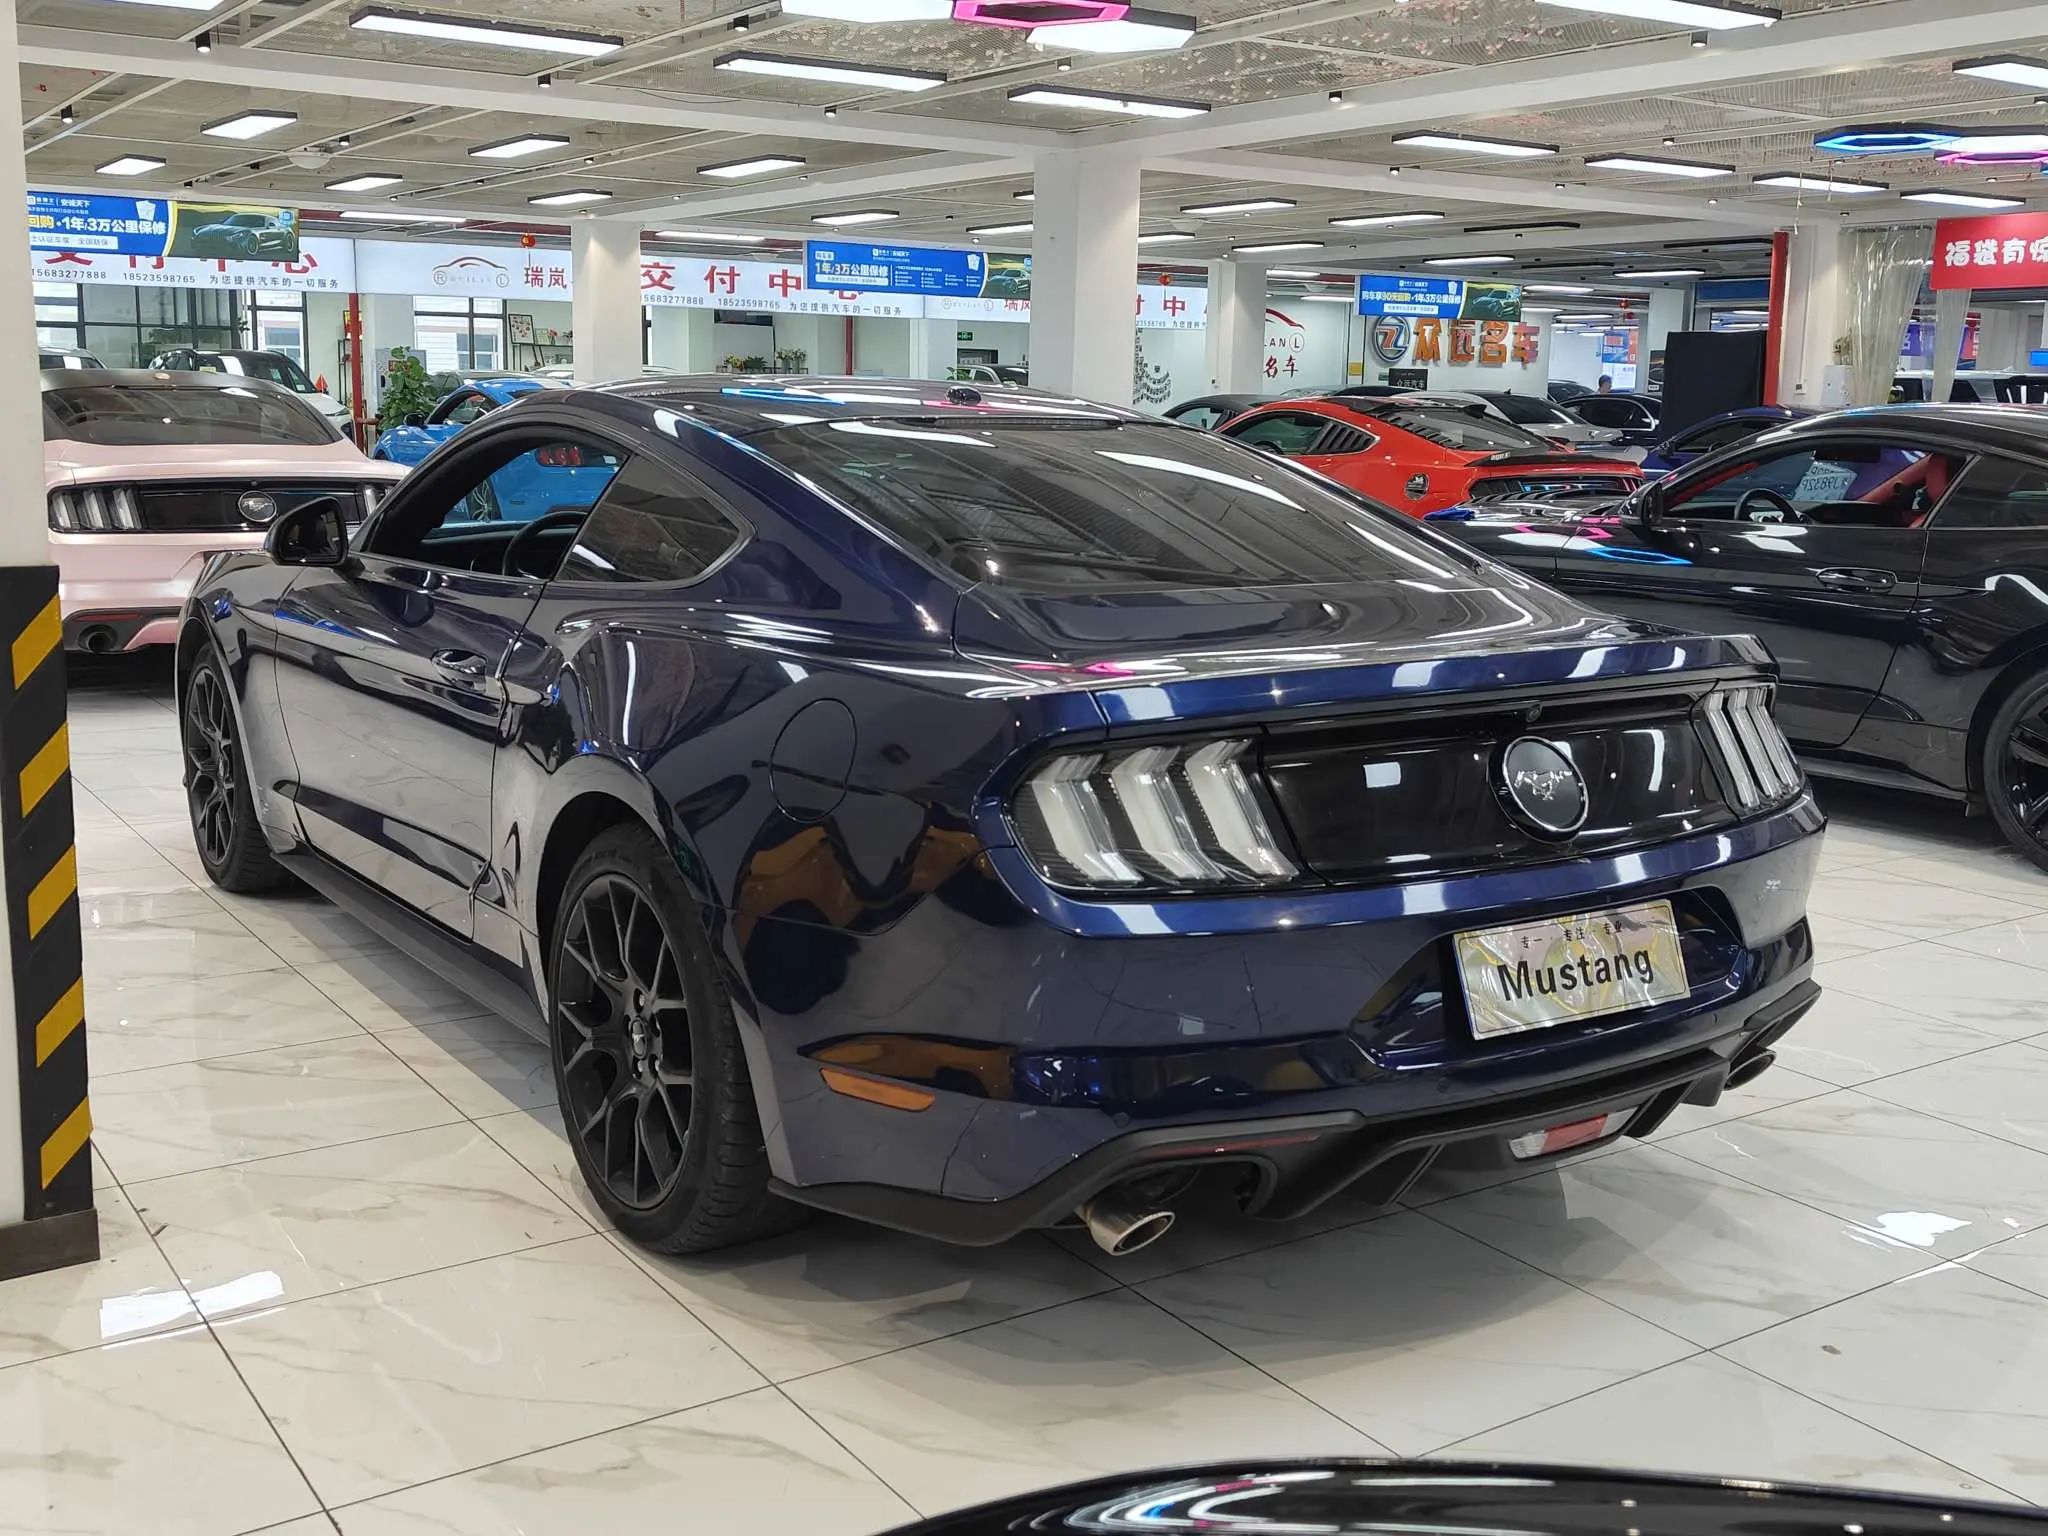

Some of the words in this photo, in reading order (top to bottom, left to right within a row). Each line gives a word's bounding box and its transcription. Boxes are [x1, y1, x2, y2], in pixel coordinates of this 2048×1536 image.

[32, 268, 107, 280] 15683277888
[122, 272, 196, 284] 18523598765
[209, 274, 339, 289] 为您提供汽车的一切服务
[524, 266, 567, 289] 瑞岚
[789, 301, 902, 317] 为您提供汽车的一切服务
[1563, 926, 1585, 942] 专注
[1497, 949, 1654, 1002] Mustang
